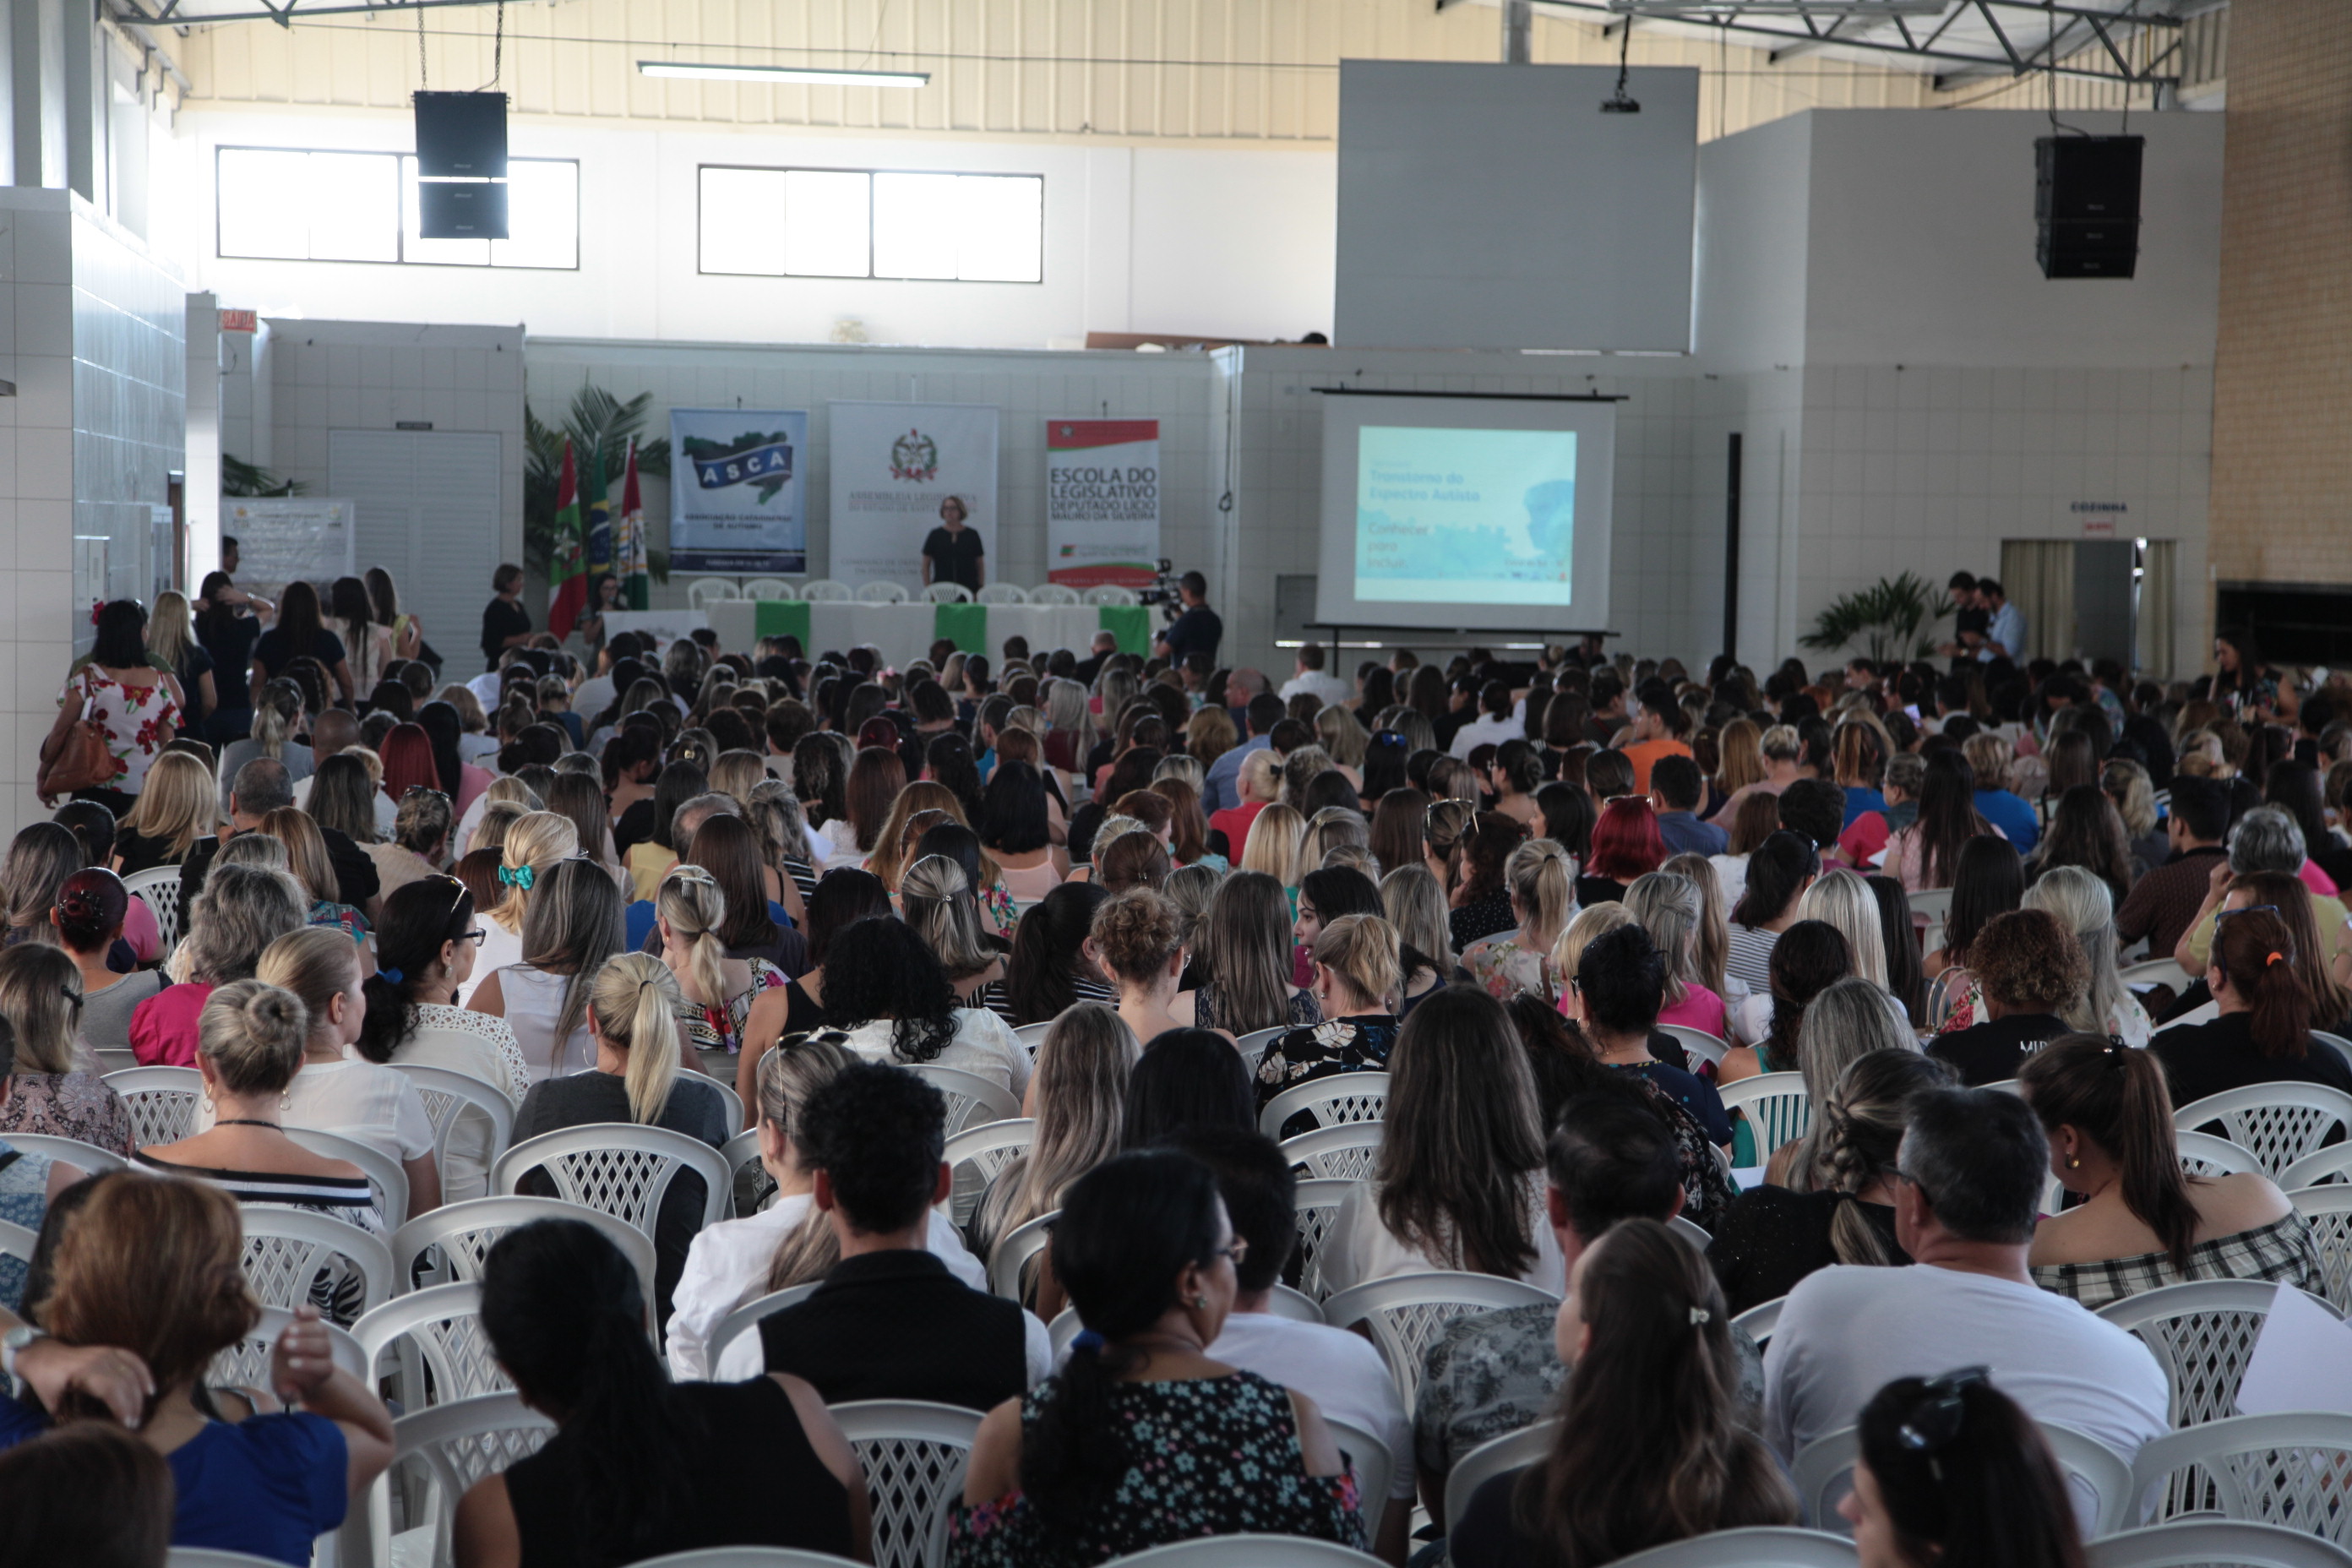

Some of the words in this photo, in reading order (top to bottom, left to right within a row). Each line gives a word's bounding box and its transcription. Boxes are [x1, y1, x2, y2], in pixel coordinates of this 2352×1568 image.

[703, 451, 785, 482] ASCA
[1050, 468, 1122, 482] ESCOLA
[1128, 468, 1156, 482] DO
[1050, 485, 1156, 498] LEGISLATIVO
[1050, 500, 1120, 511] DEPUTADO
